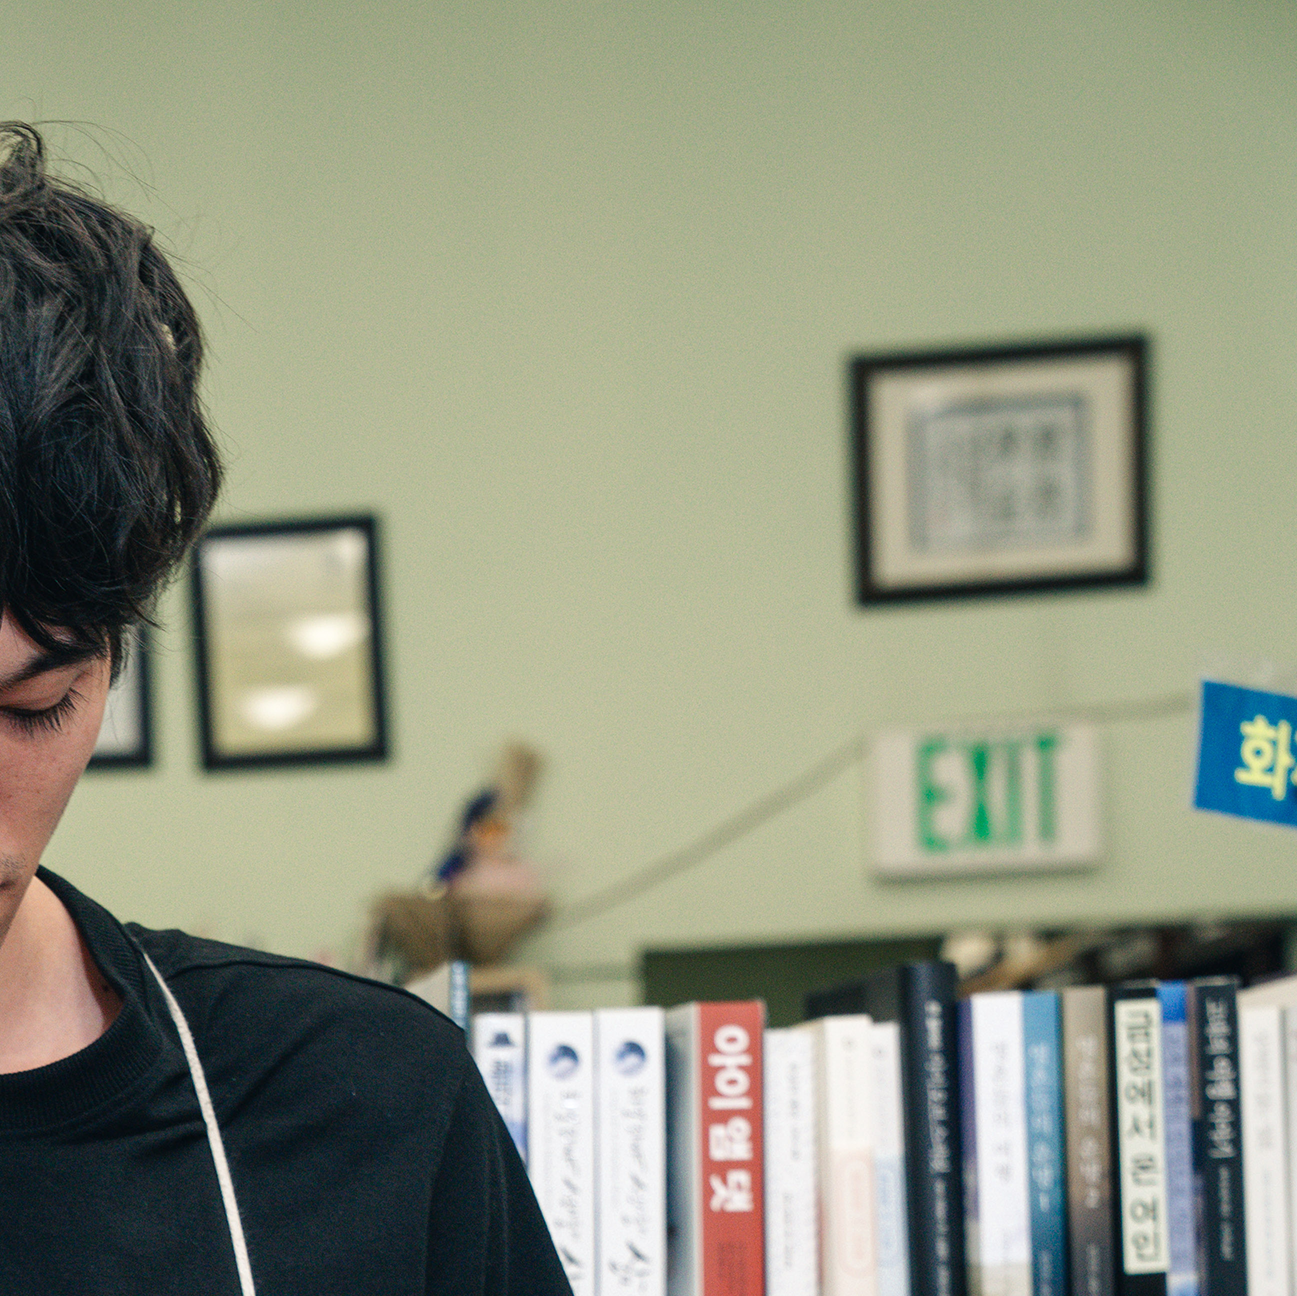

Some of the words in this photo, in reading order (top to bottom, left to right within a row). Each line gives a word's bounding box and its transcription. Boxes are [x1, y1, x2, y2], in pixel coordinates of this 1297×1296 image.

[916, 729, 1060, 853] EXIT
[1234, 714, 1297, 802] 화
[708, 1024, 753, 1110] 아이
